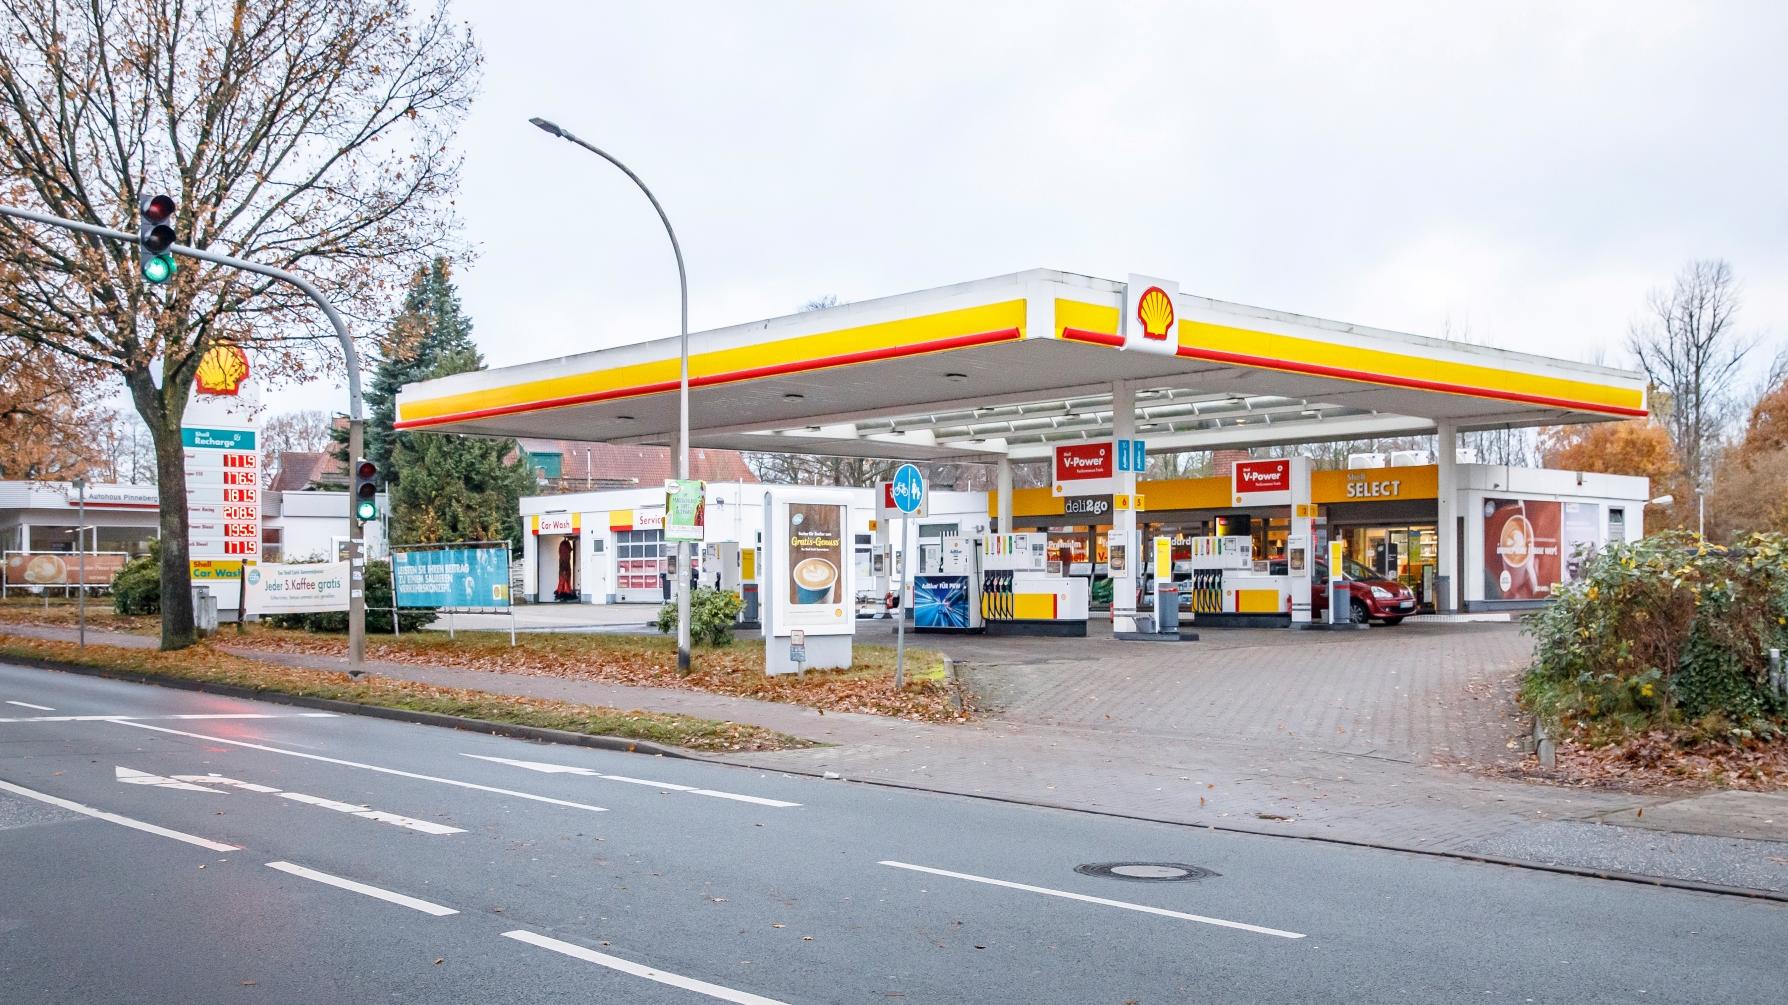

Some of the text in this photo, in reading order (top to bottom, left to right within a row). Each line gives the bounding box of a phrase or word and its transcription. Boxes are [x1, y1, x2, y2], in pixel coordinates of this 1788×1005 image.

[194, 437, 236, 448] Recharge
[1063, 456, 1104, 469] V-Power
[1243, 471, 1281, 482] V-Power
[1347, 472, 1366, 481] Shell
[1347, 480, 1400, 498] SELECT
[123, 494, 158, 503] Pinneberg
[1122, 498, 1127, 506] 6
[1065, 499, 1108, 515] deli2go
[541, 520, 570, 530] Car Wash
[791, 536, 840, 547] Gratis-Genuss
[193, 560, 212, 568] Shell
[193, 568, 211, 578] Car
[264, 579, 283, 592] Jeder
[317, 577, 341, 593] gratis
